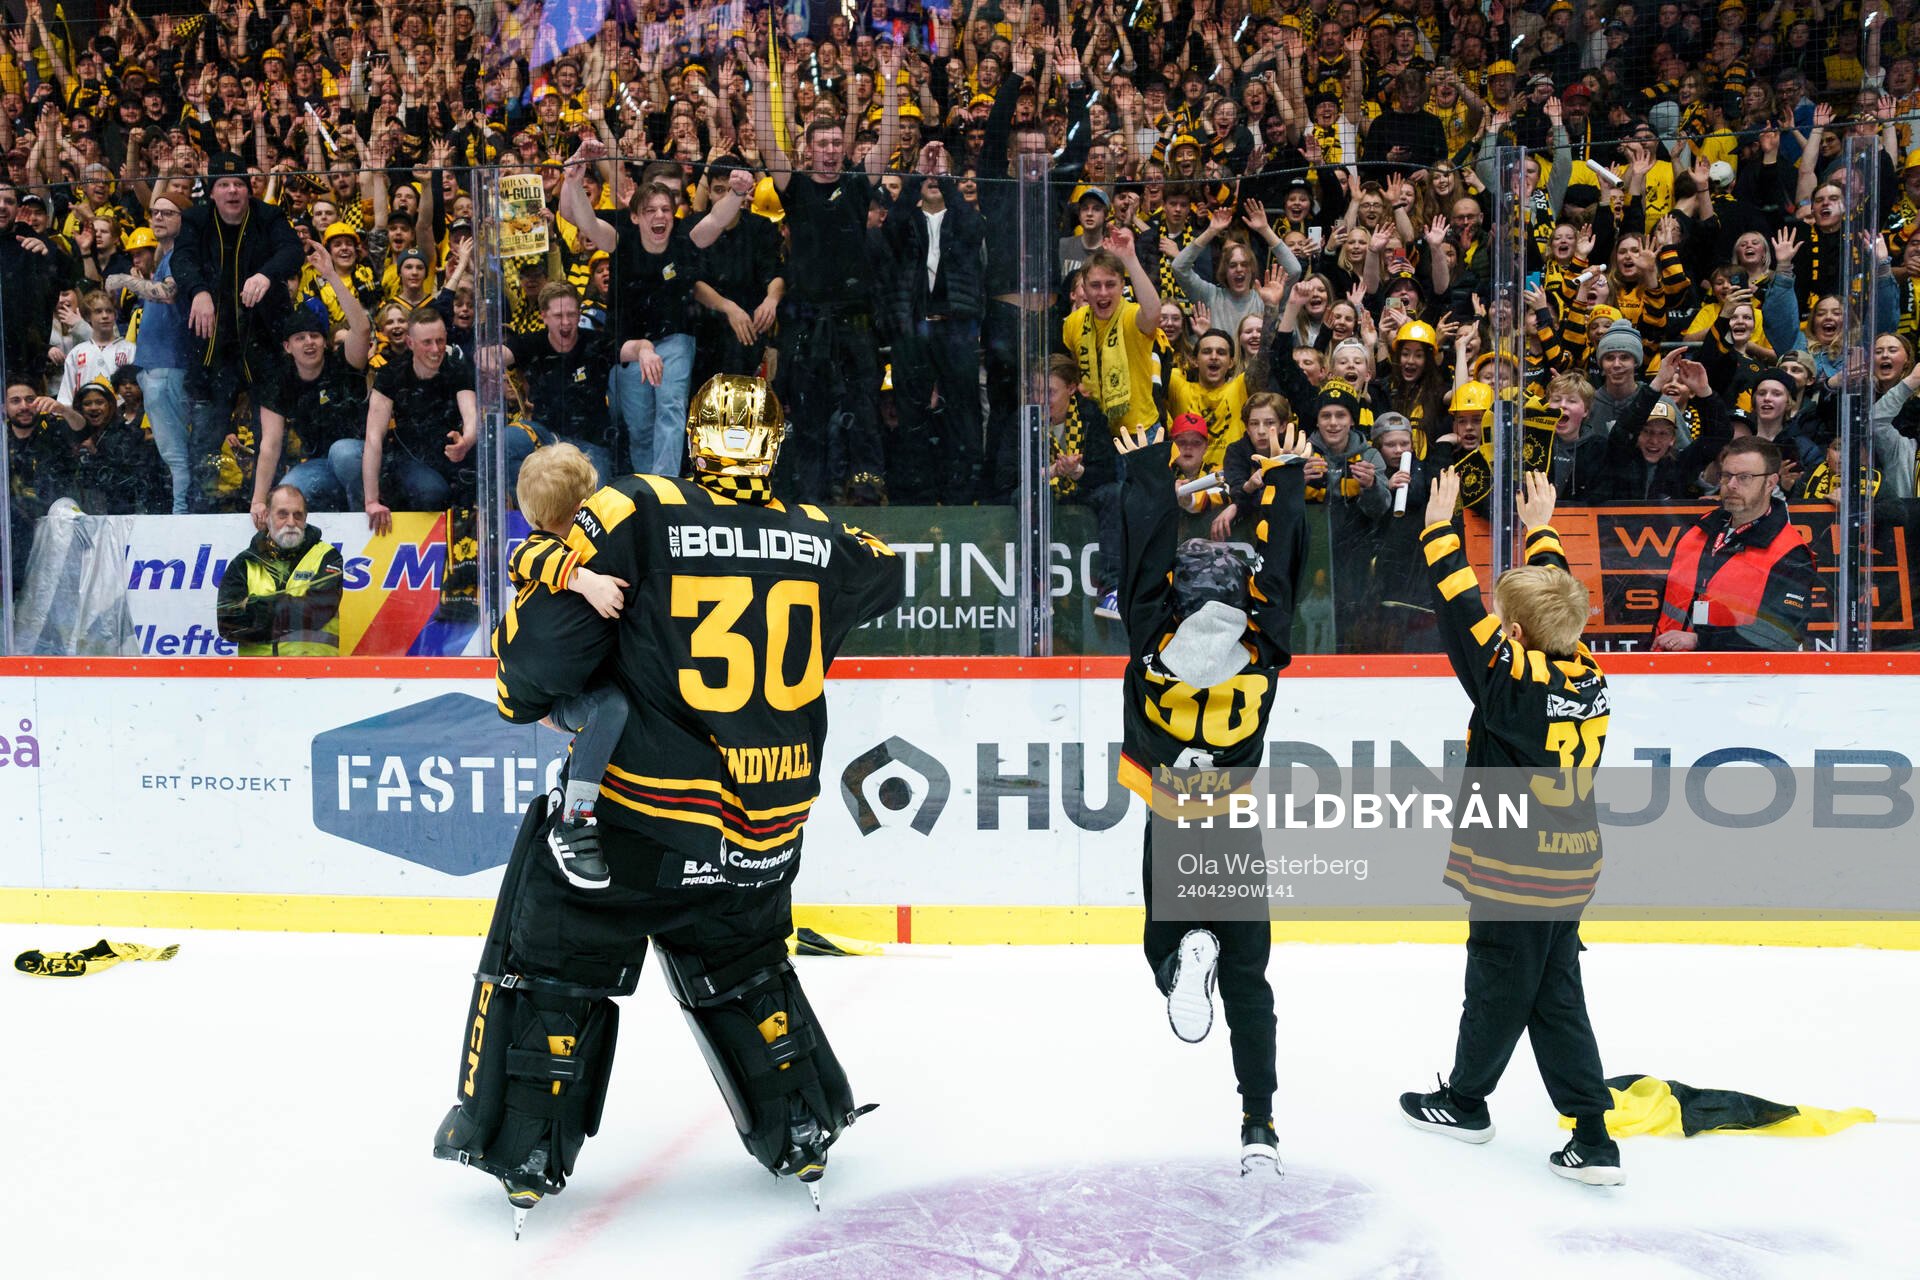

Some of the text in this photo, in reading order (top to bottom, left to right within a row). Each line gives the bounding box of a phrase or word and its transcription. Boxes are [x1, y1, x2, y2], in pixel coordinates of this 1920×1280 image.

[500, 186, 541, 200] M-GULD
[668, 525, 681, 558] NEW
[681, 525, 832, 569] BOLIDEN
[897, 605, 1016, 629] HOLMEN
[670, 575, 825, 713] 30
[719, 743, 812, 785] NDVALL
[1160, 763, 1232, 794] PAPPA
[142, 775, 291, 792] ERT PROJEKT
[1596, 746, 1915, 829] JOB
